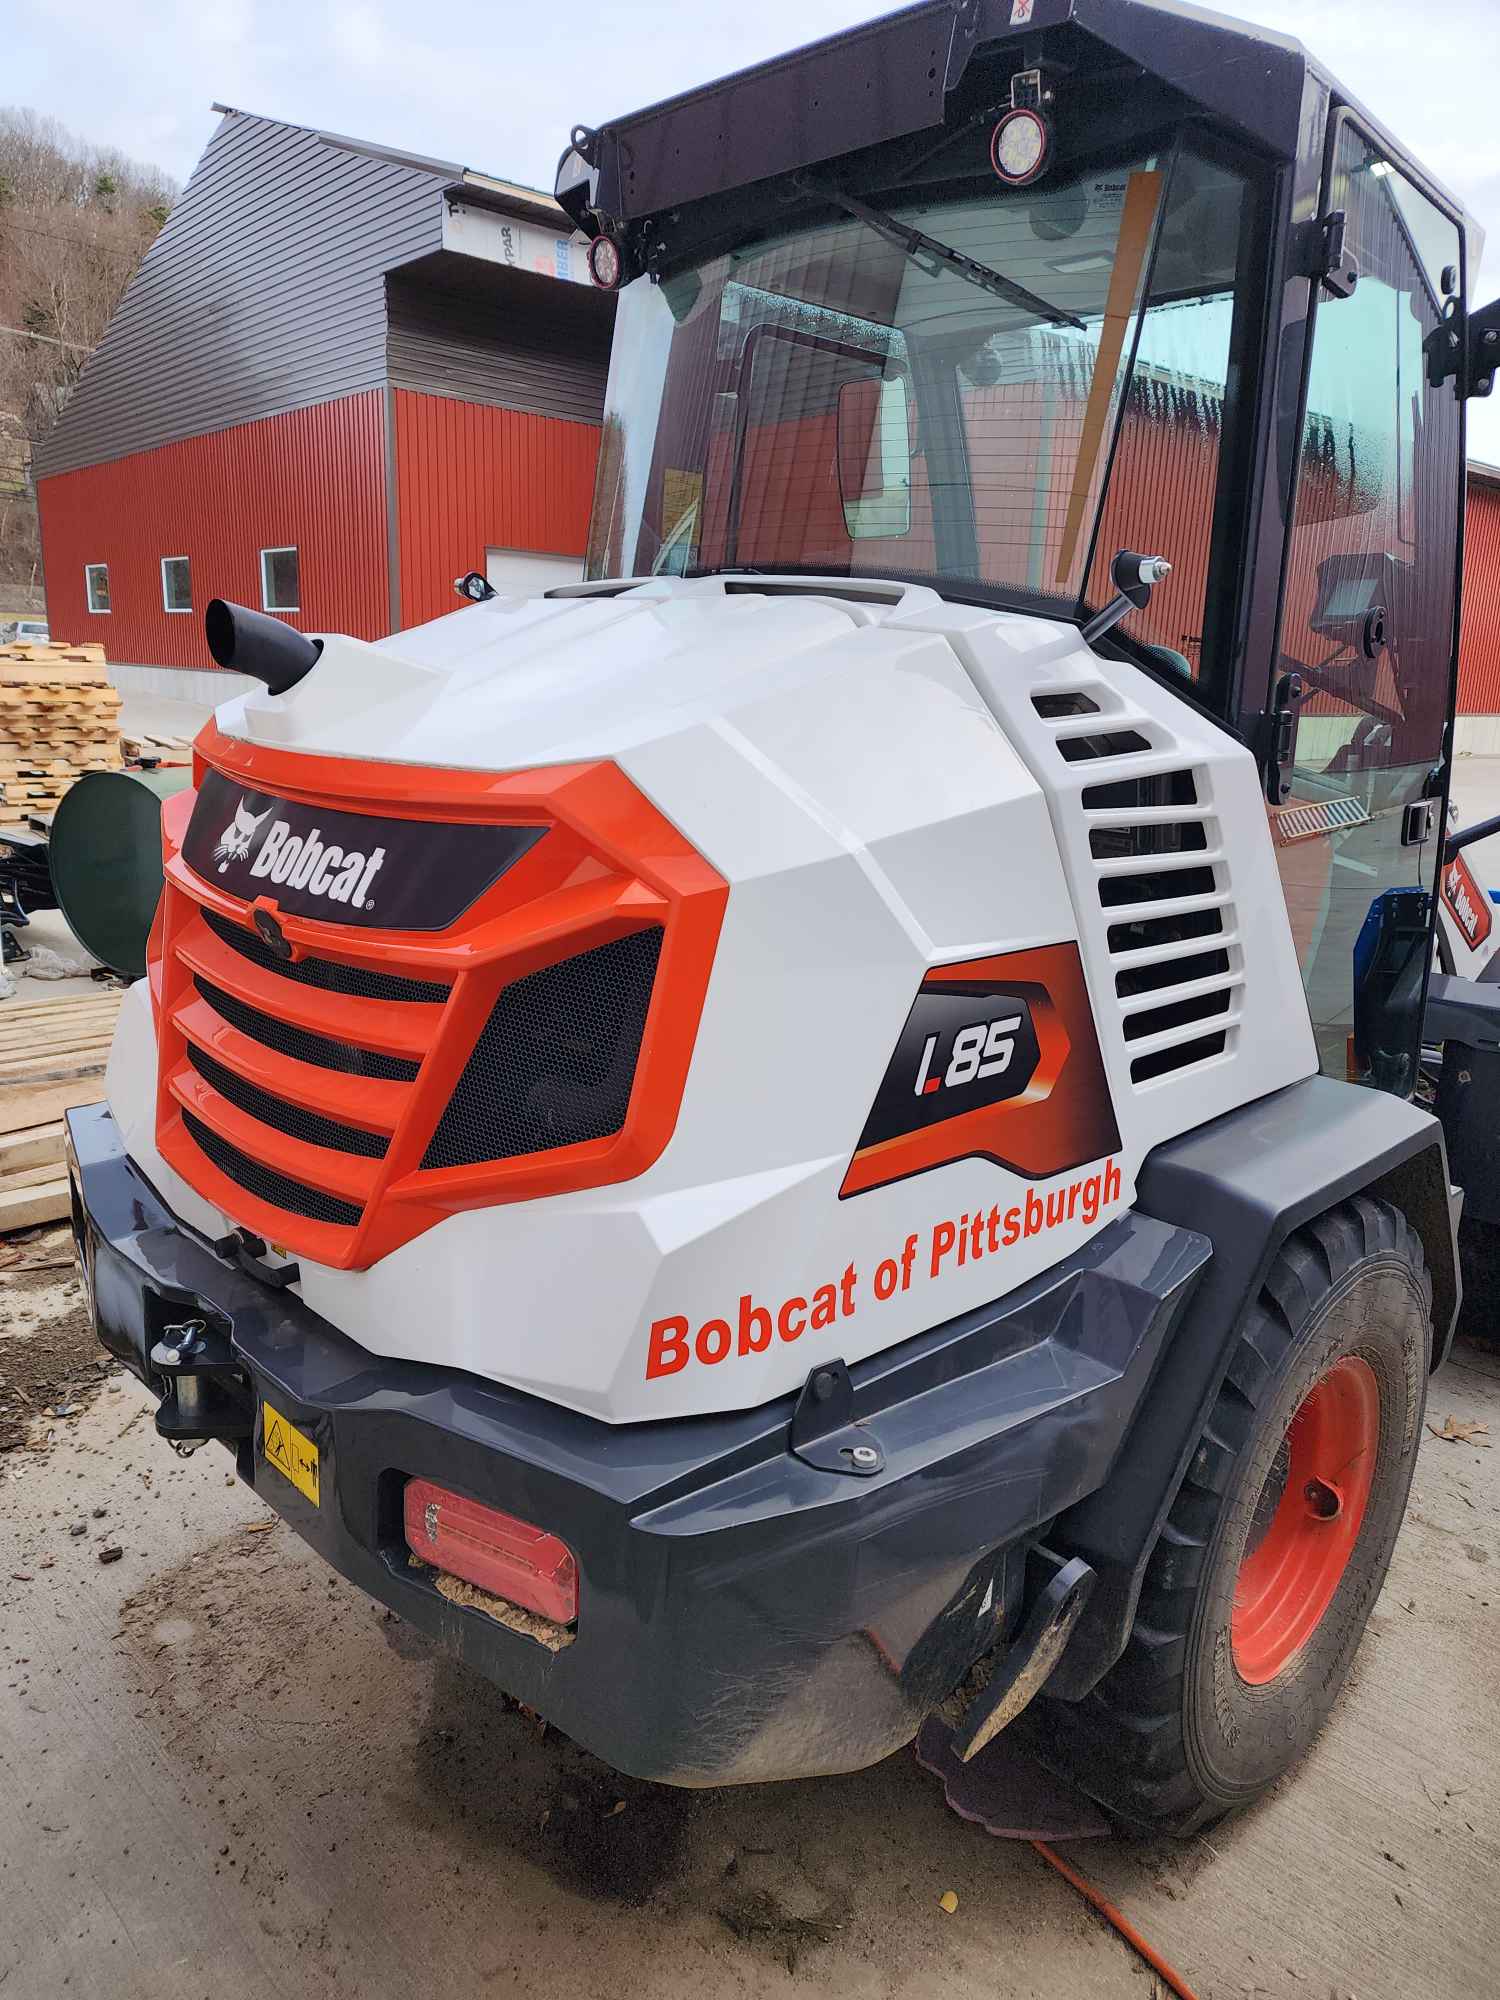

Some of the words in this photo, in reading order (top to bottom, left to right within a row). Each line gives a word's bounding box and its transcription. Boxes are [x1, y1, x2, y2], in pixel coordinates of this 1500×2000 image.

[250, 820, 386, 908] Bobcat
[646, 1260, 857, 1380] Bobcat
[874, 1234, 918, 1301] of
[930, 1159, 1121, 1278] Pittsburgh
